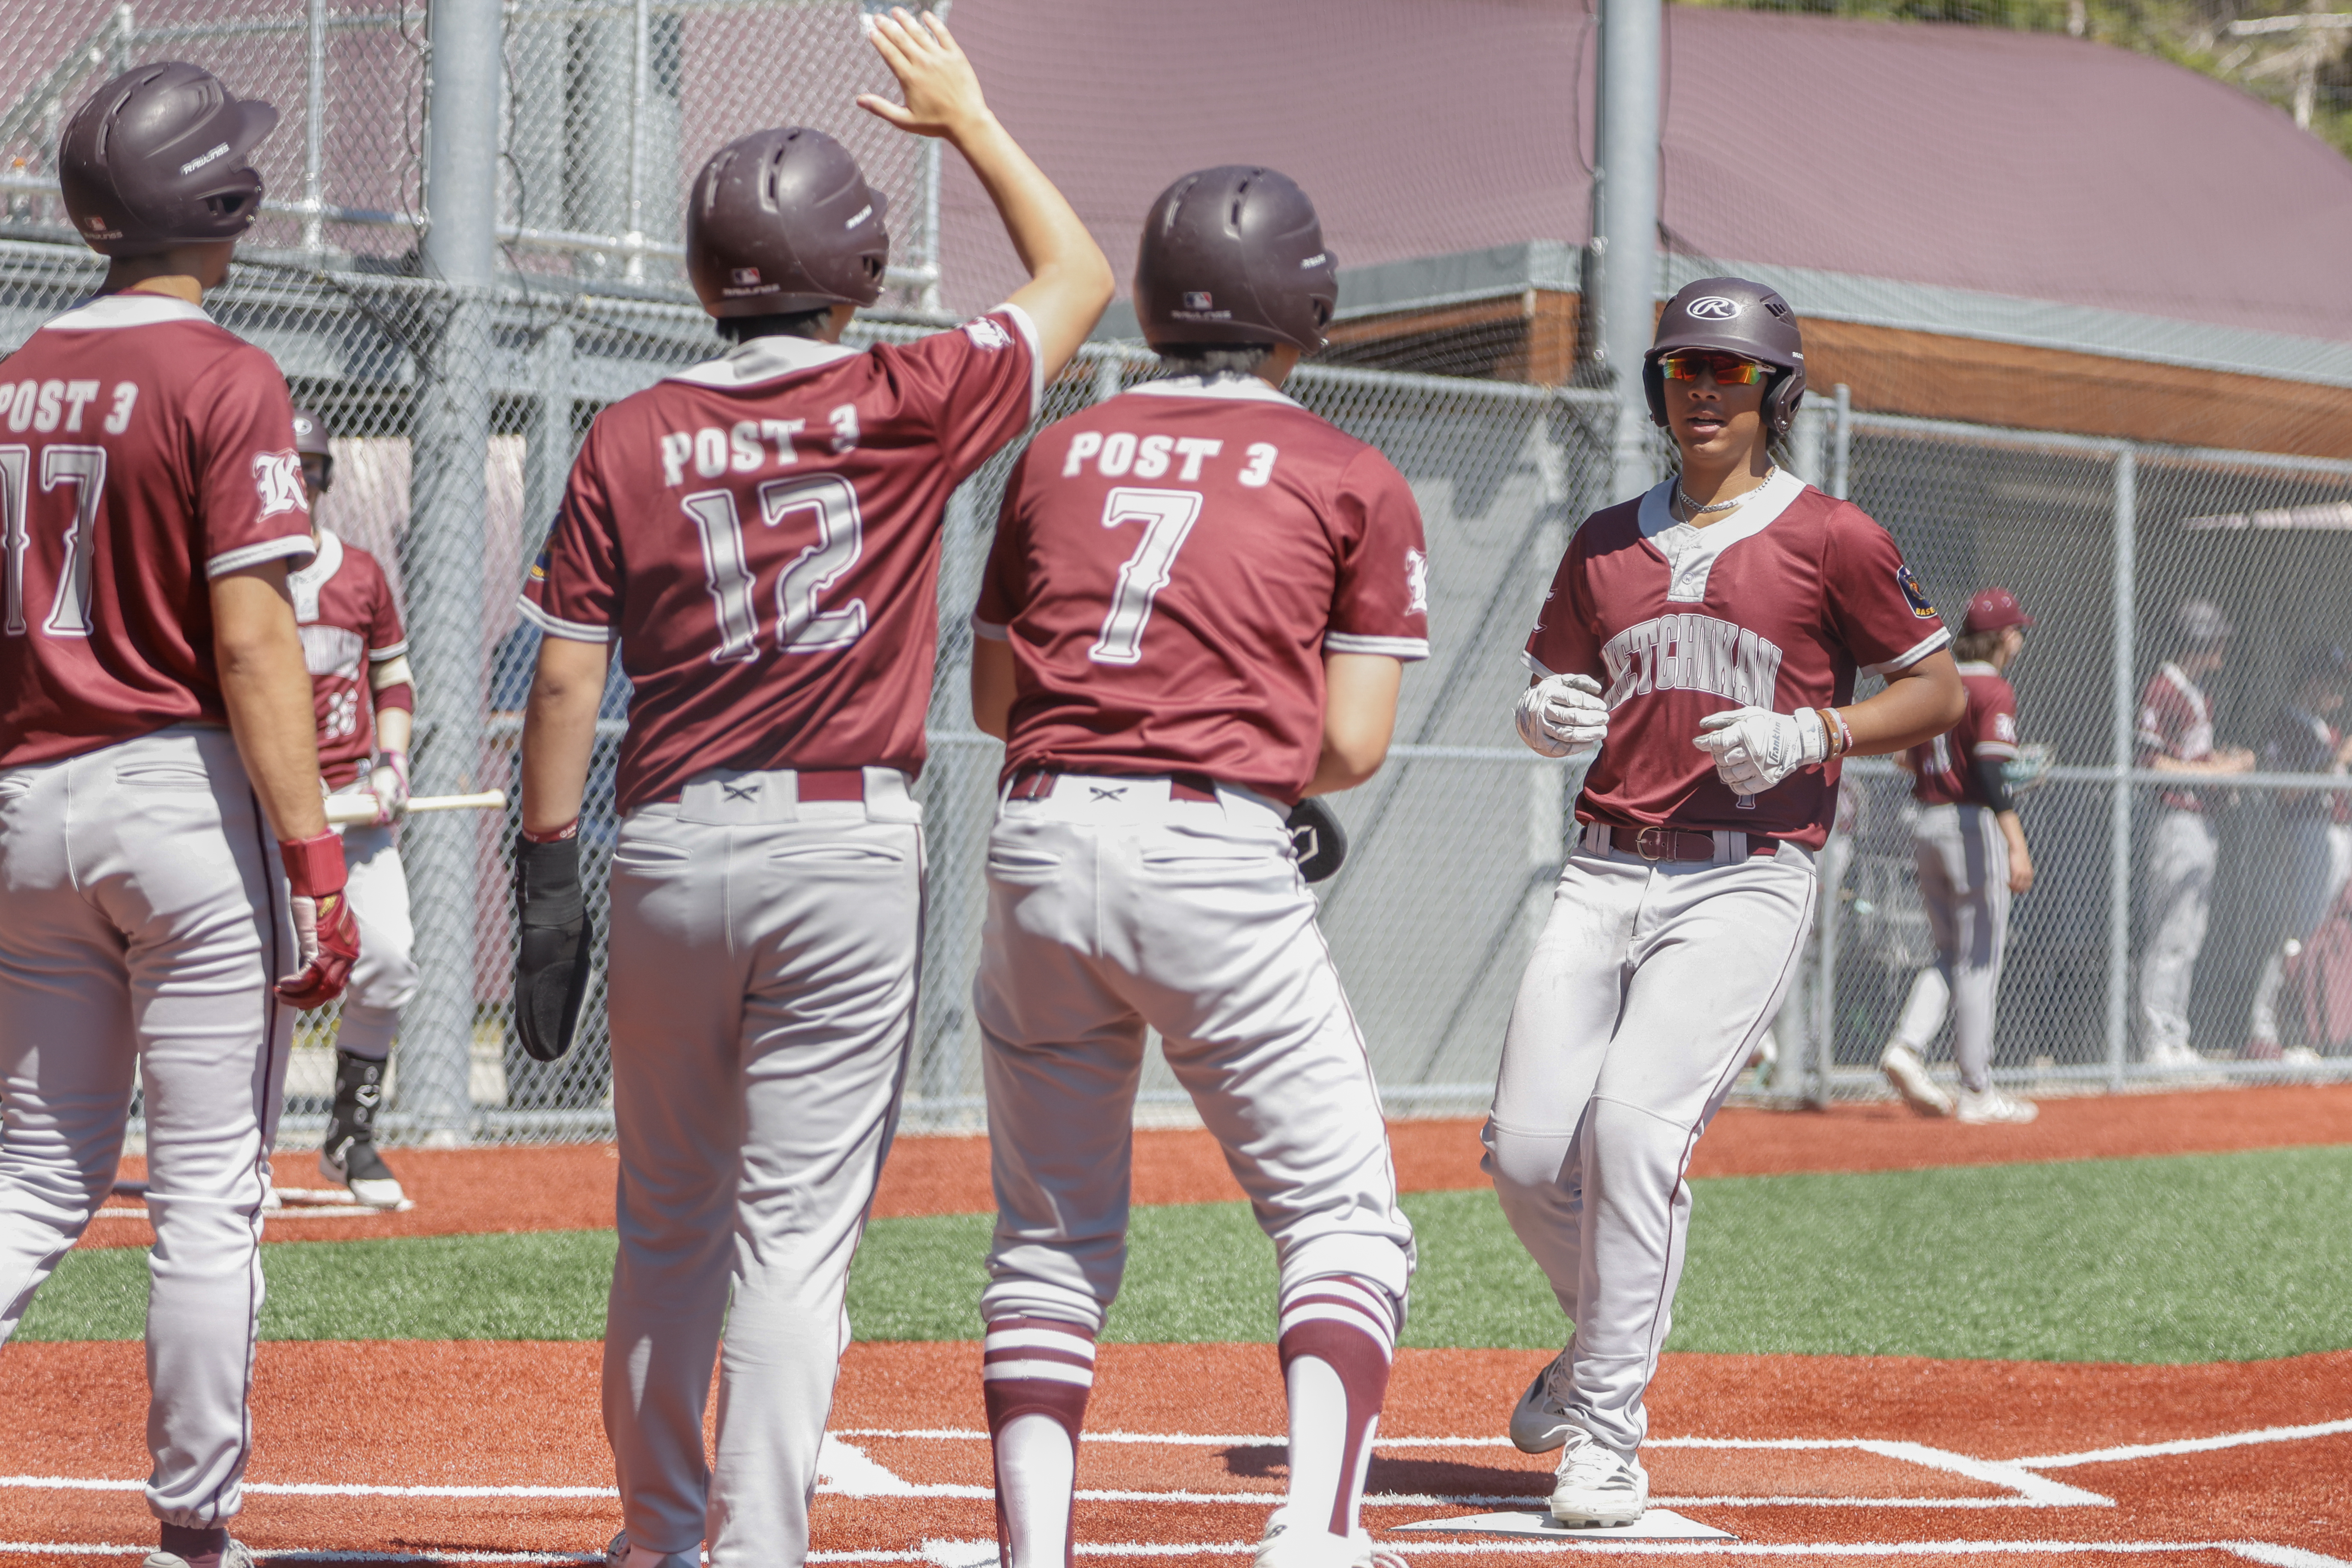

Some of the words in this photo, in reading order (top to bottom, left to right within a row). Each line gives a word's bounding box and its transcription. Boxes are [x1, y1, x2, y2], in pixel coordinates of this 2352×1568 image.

[181, 142, 230, 175] RAWLINGS
[105, 381, 139, 434] 3
[661, 418, 805, 486] POST
[829, 403, 860, 453] 3
[1062, 431, 1223, 483] POST
[1237, 442, 1278, 487] 3
[0, 444, 107, 636] 17
[681, 473, 867, 664] 12
[1089, 487, 1203, 664] 7
[1916, 607, 1936, 616] BASE
[1769, 721, 1780, 763] Franklin
